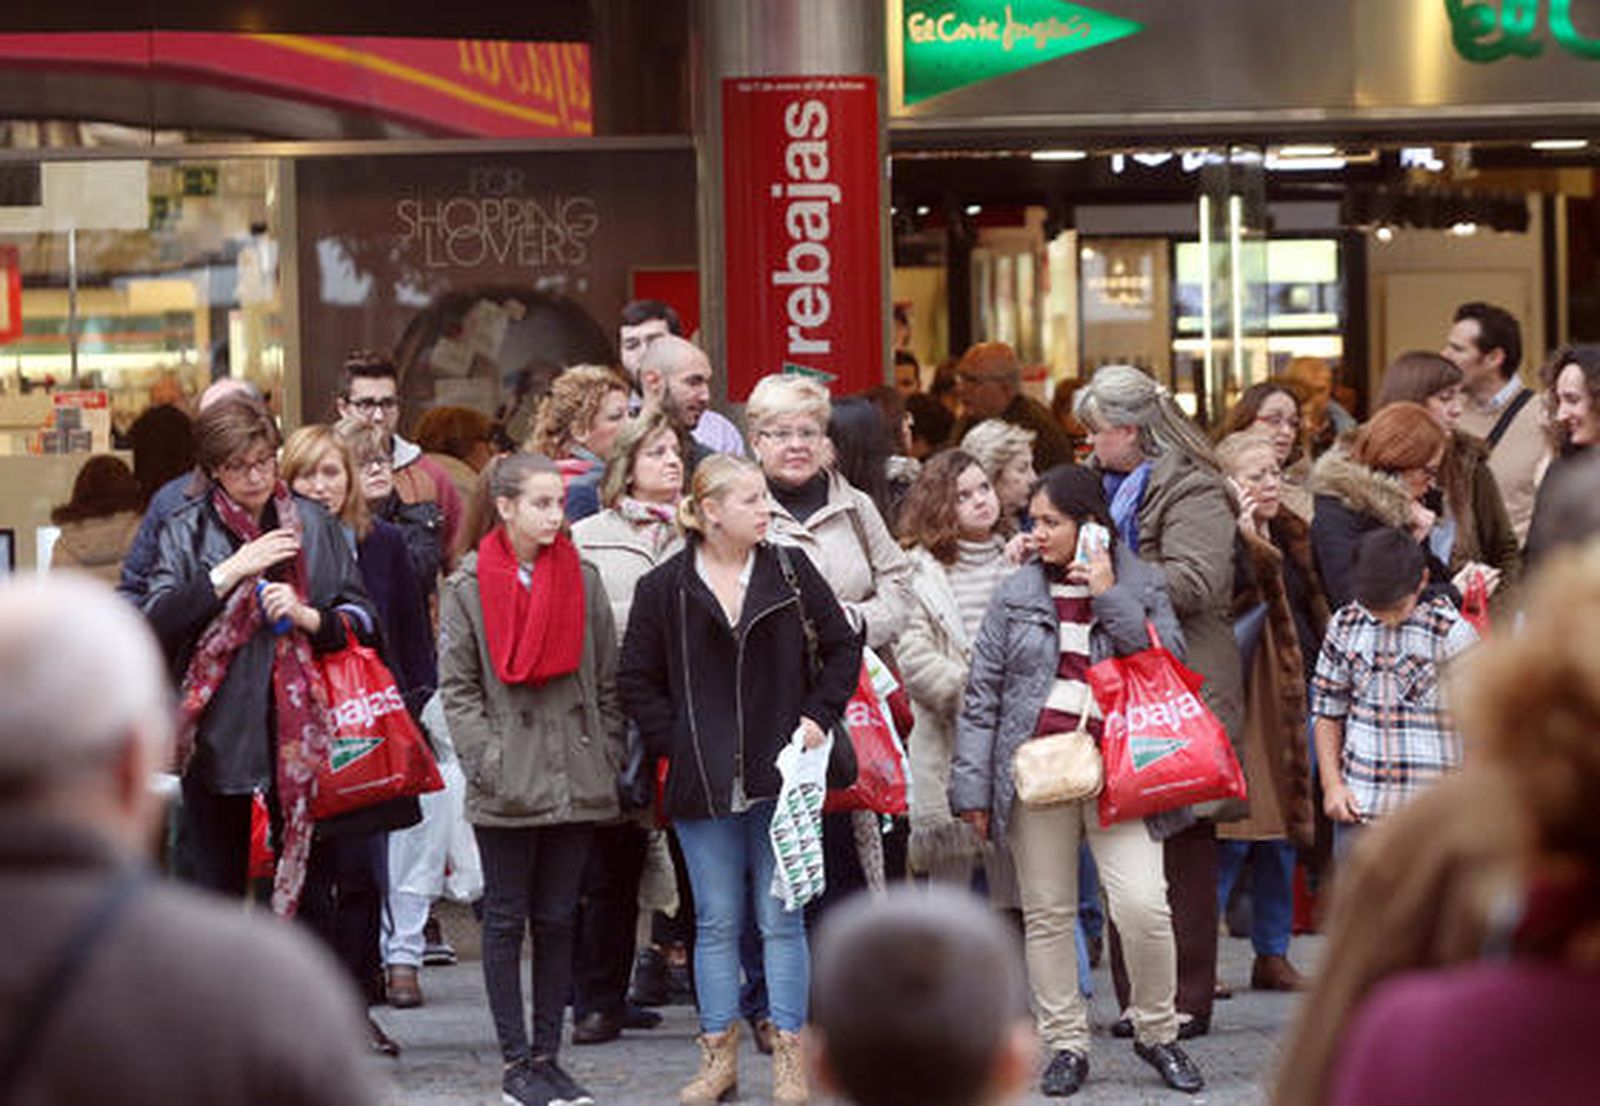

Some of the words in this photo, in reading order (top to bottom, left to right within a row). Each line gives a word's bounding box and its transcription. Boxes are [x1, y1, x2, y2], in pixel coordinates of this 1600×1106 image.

[397, 196, 599, 241] SHOPPING
[771, 99, 842, 354] rebajas
[424, 225, 588, 267] LOVERS
